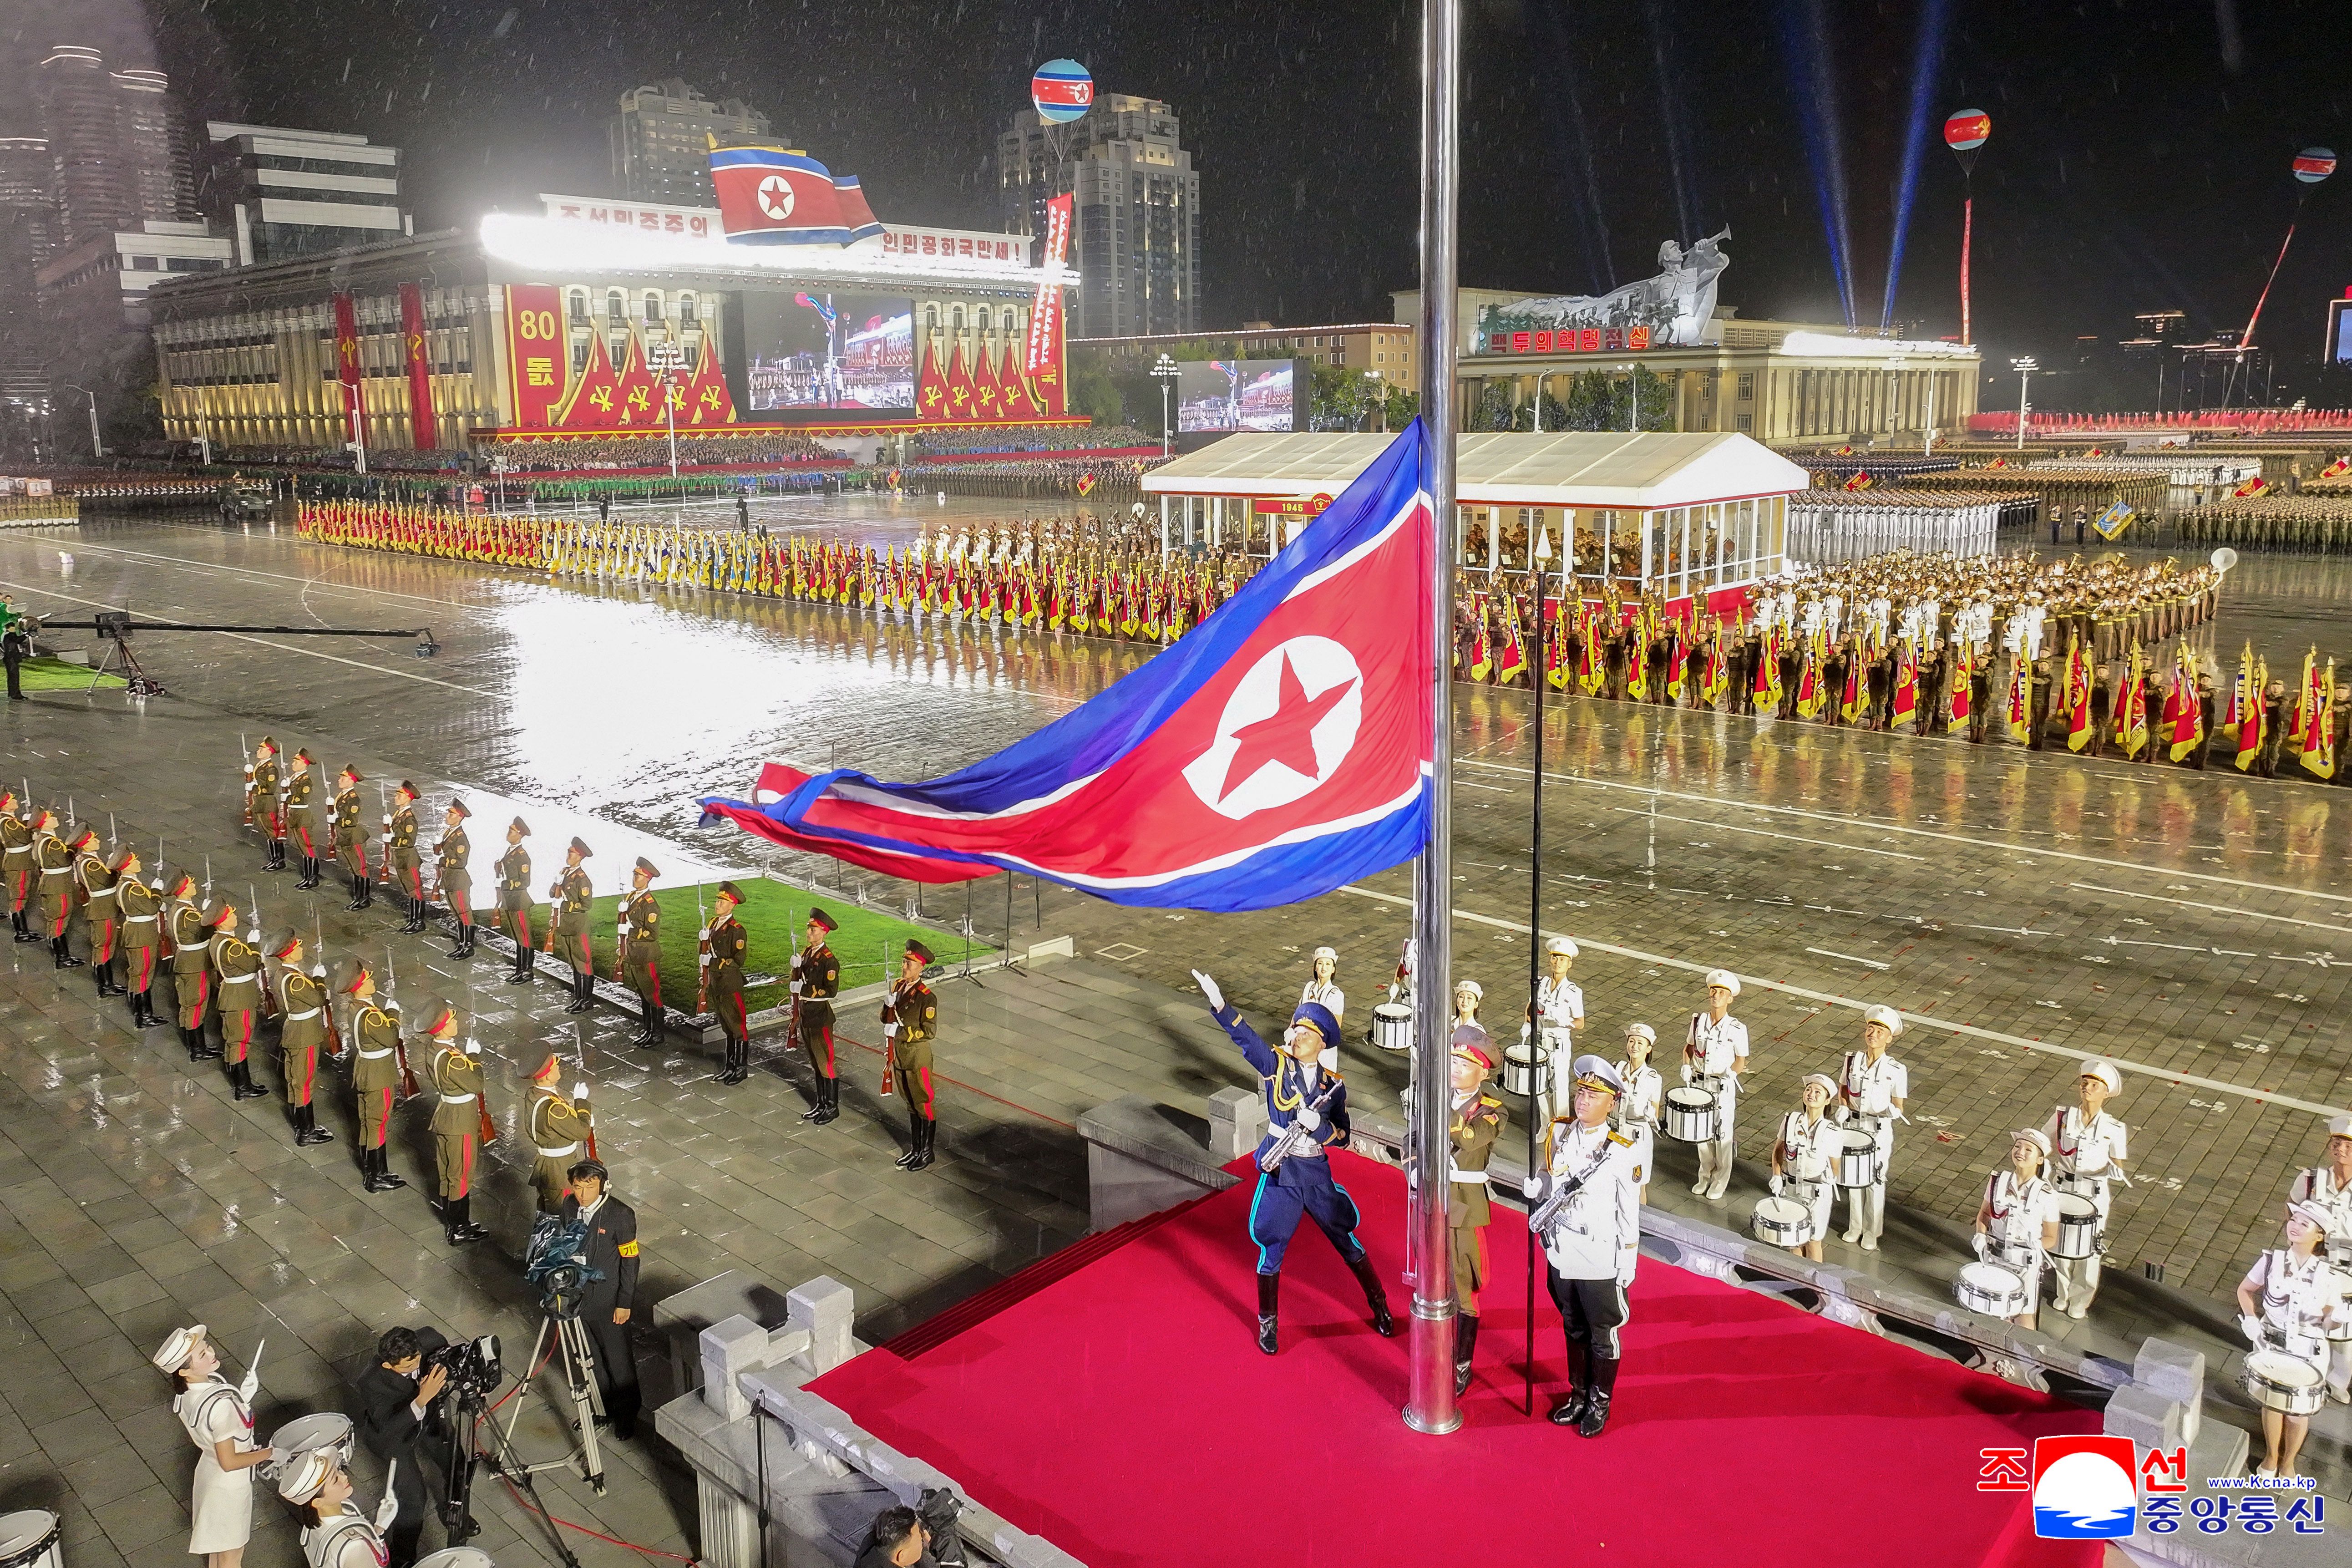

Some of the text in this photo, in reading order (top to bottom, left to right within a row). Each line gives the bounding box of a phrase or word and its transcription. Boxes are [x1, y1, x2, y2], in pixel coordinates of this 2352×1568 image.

[520, 310, 555, 340] 80
[526, 357, 555, 386] 돐
[1282, 503, 1303, 512] 1945
